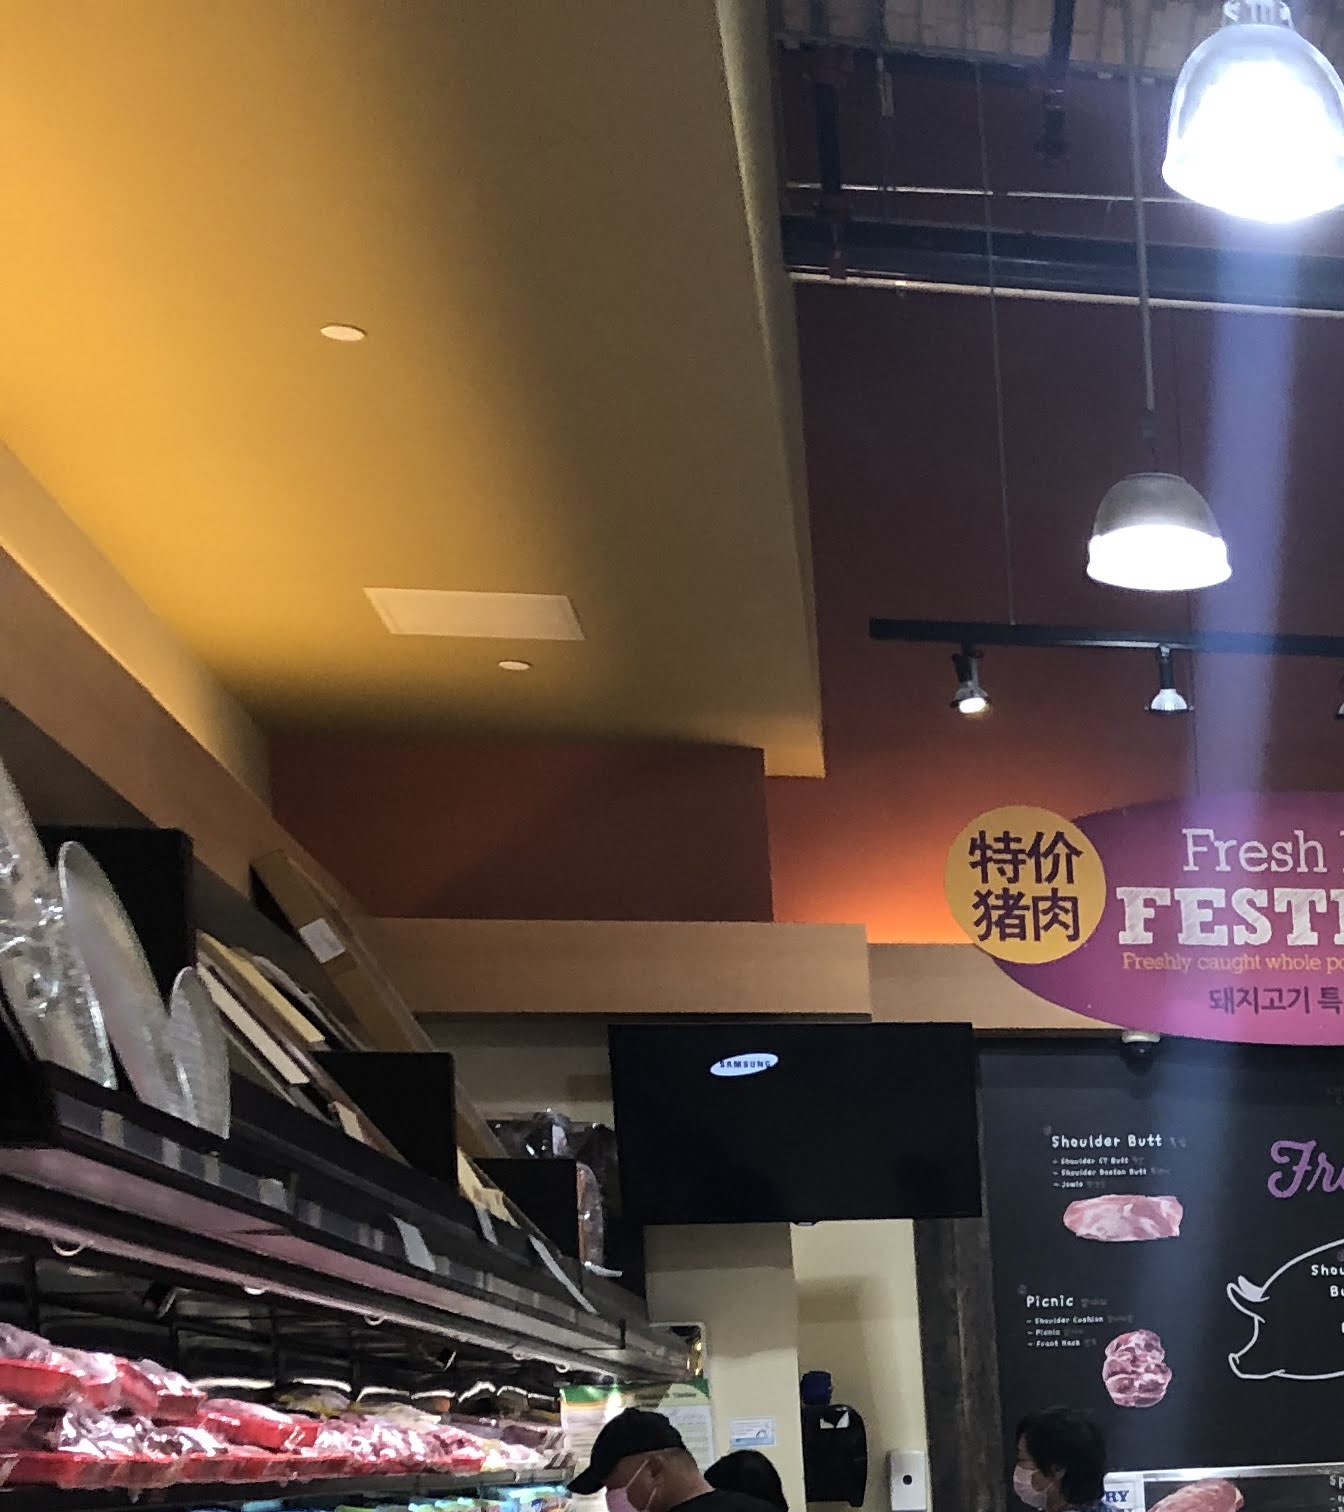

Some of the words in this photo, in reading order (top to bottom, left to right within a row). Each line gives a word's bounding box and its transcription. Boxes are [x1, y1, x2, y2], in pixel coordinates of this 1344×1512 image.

[968, 829, 1083, 885] 特价
[1182, 829, 1329, 873] Fresh
[973, 888, 1081, 942] 猪肉
[1122, 951, 1192, 974] Freshly
[1197, 953, 1261, 974] caught
[1264, 952, 1321, 972] whole
[1209, 985, 1311, 1016] 돼지고기
[719, 1060, 772, 1069] SAMSUNG
[1051, 1134, 1121, 1149] Shoulder
[1128, 1134, 1162, 1147] Butt
[1026, 1295, 1074, 1308] Picnic
